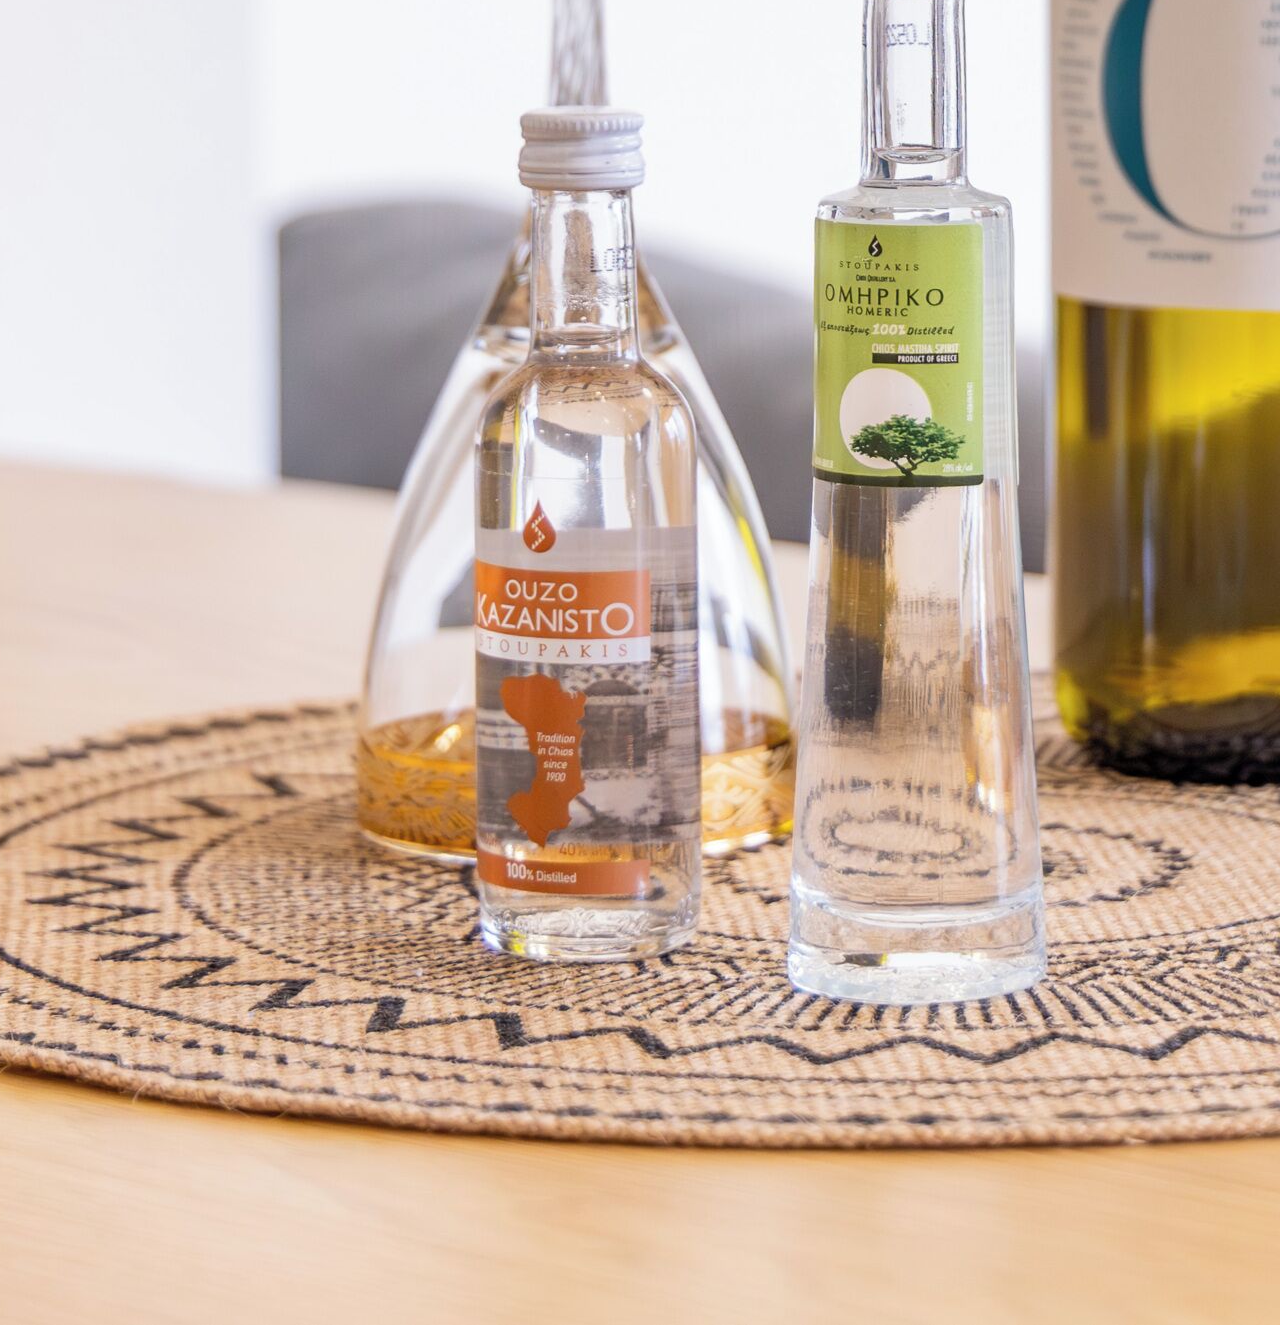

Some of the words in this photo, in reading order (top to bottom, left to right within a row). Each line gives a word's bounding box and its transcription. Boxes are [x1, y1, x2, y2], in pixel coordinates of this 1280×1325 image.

[839, 260, 919, 271] STOUPAKIS
[847, 305, 908, 317] HOMERIC
[872, 323, 906, 336] 100%
[907, 326, 955, 336] Distilled
[872, 343, 895, 353] CHIOS
[935, 343, 959, 354] SPIRIT
[897, 355, 924, 363] PRODUCT
[926, 355, 934, 363] OF
[505, 579, 578, 602] OUZO
[477, 591, 634, 636] KAZANISTO
[479, 633, 628, 658] STOUPAKIS
[536, 732, 576, 743] Tradition
[538, 745, 546, 755] in
[548, 746, 574, 756] Chios
[543, 759, 568, 769] since
[546, 772, 566, 782] 1900
[506, 862, 534, 880] 100%
[536, 870, 577, 884] Distilled
